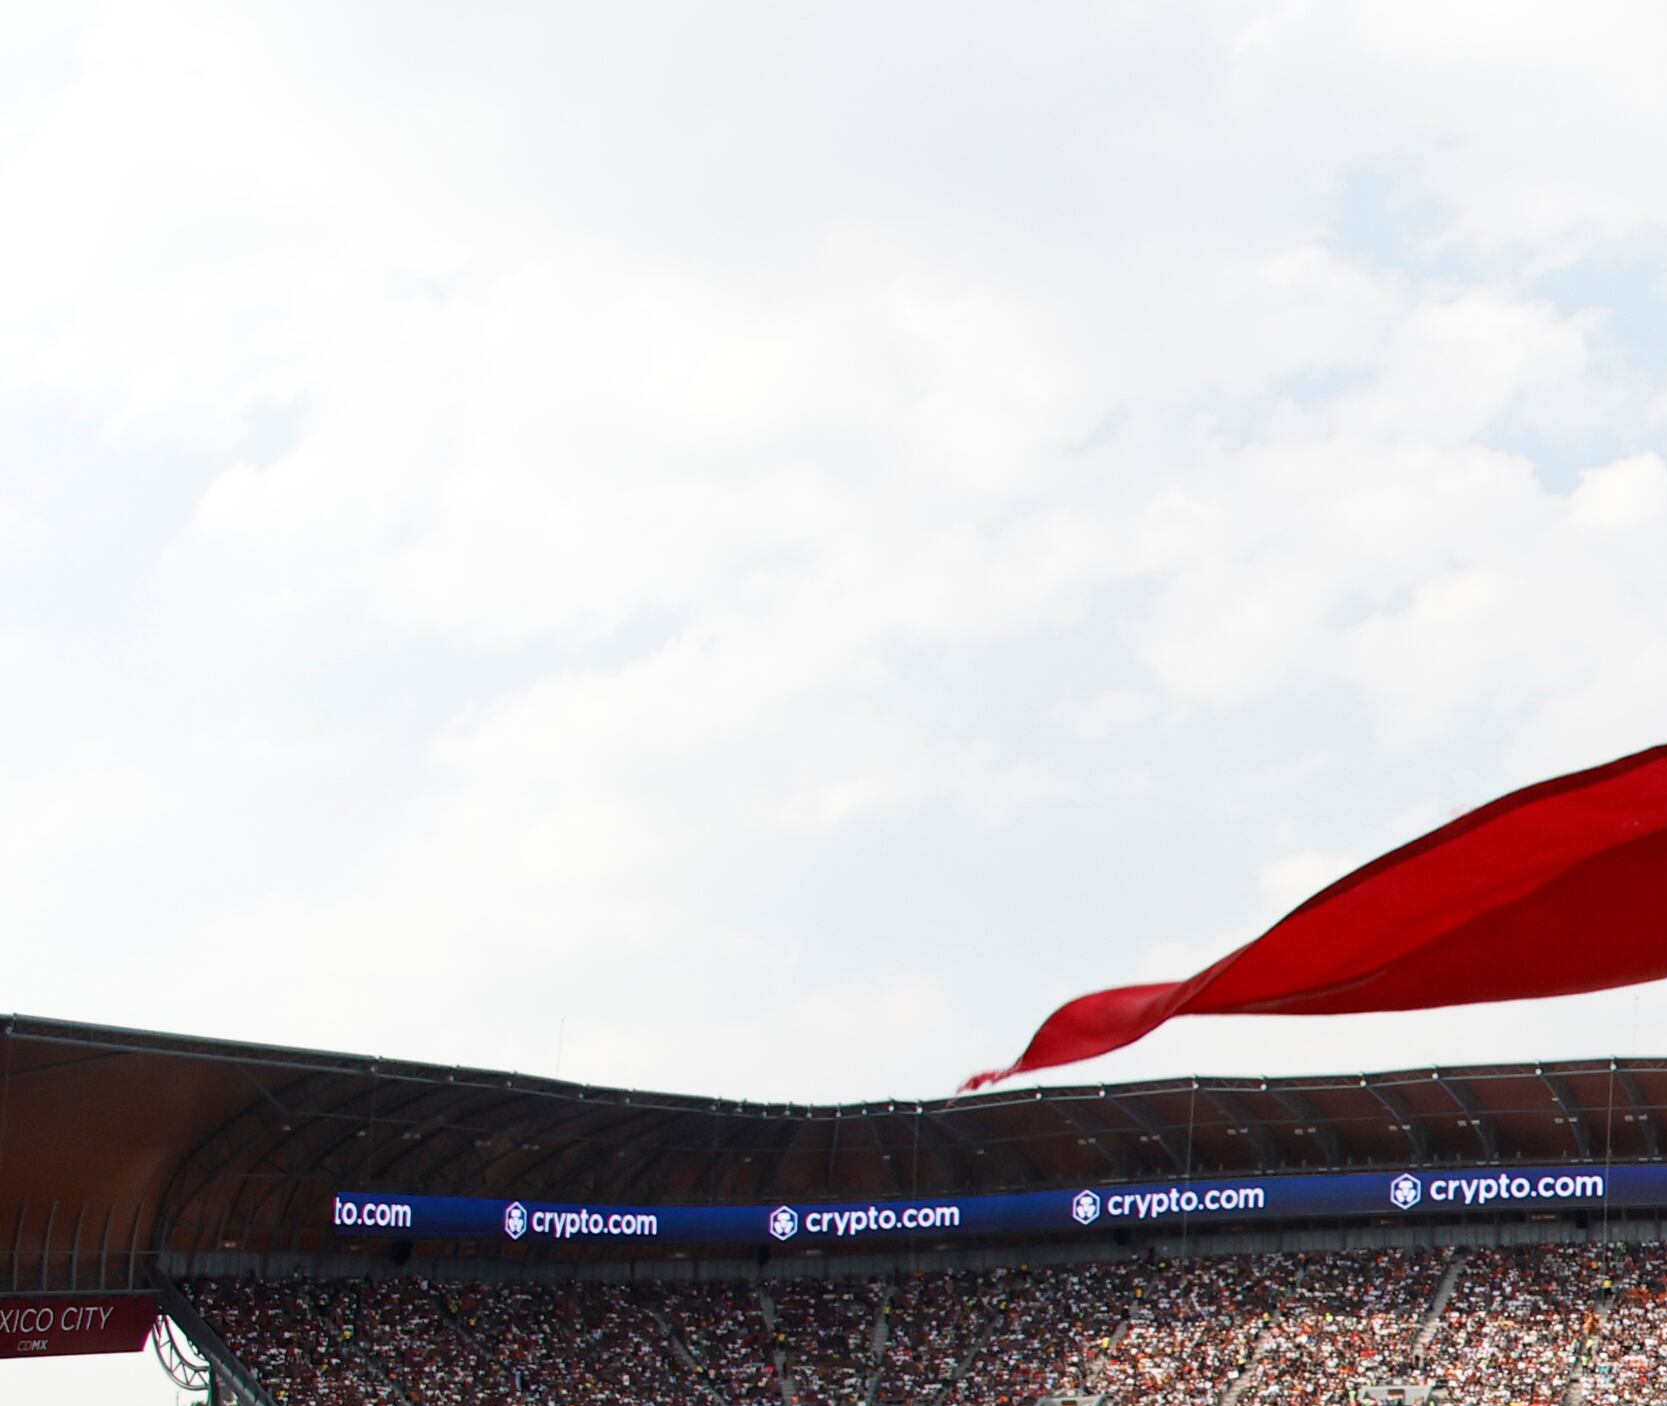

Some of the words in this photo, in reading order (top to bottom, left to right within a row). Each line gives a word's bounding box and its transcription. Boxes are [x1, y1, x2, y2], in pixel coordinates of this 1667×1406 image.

[1108, 1186, 1264, 1220] crypto.com
[1429, 1173, 1604, 1205] crypto.com
[532, 1208, 658, 1239] crypto.com
[806, 1204, 960, 1237] crypto.com
[61, 1306, 114, 1331] CITY
